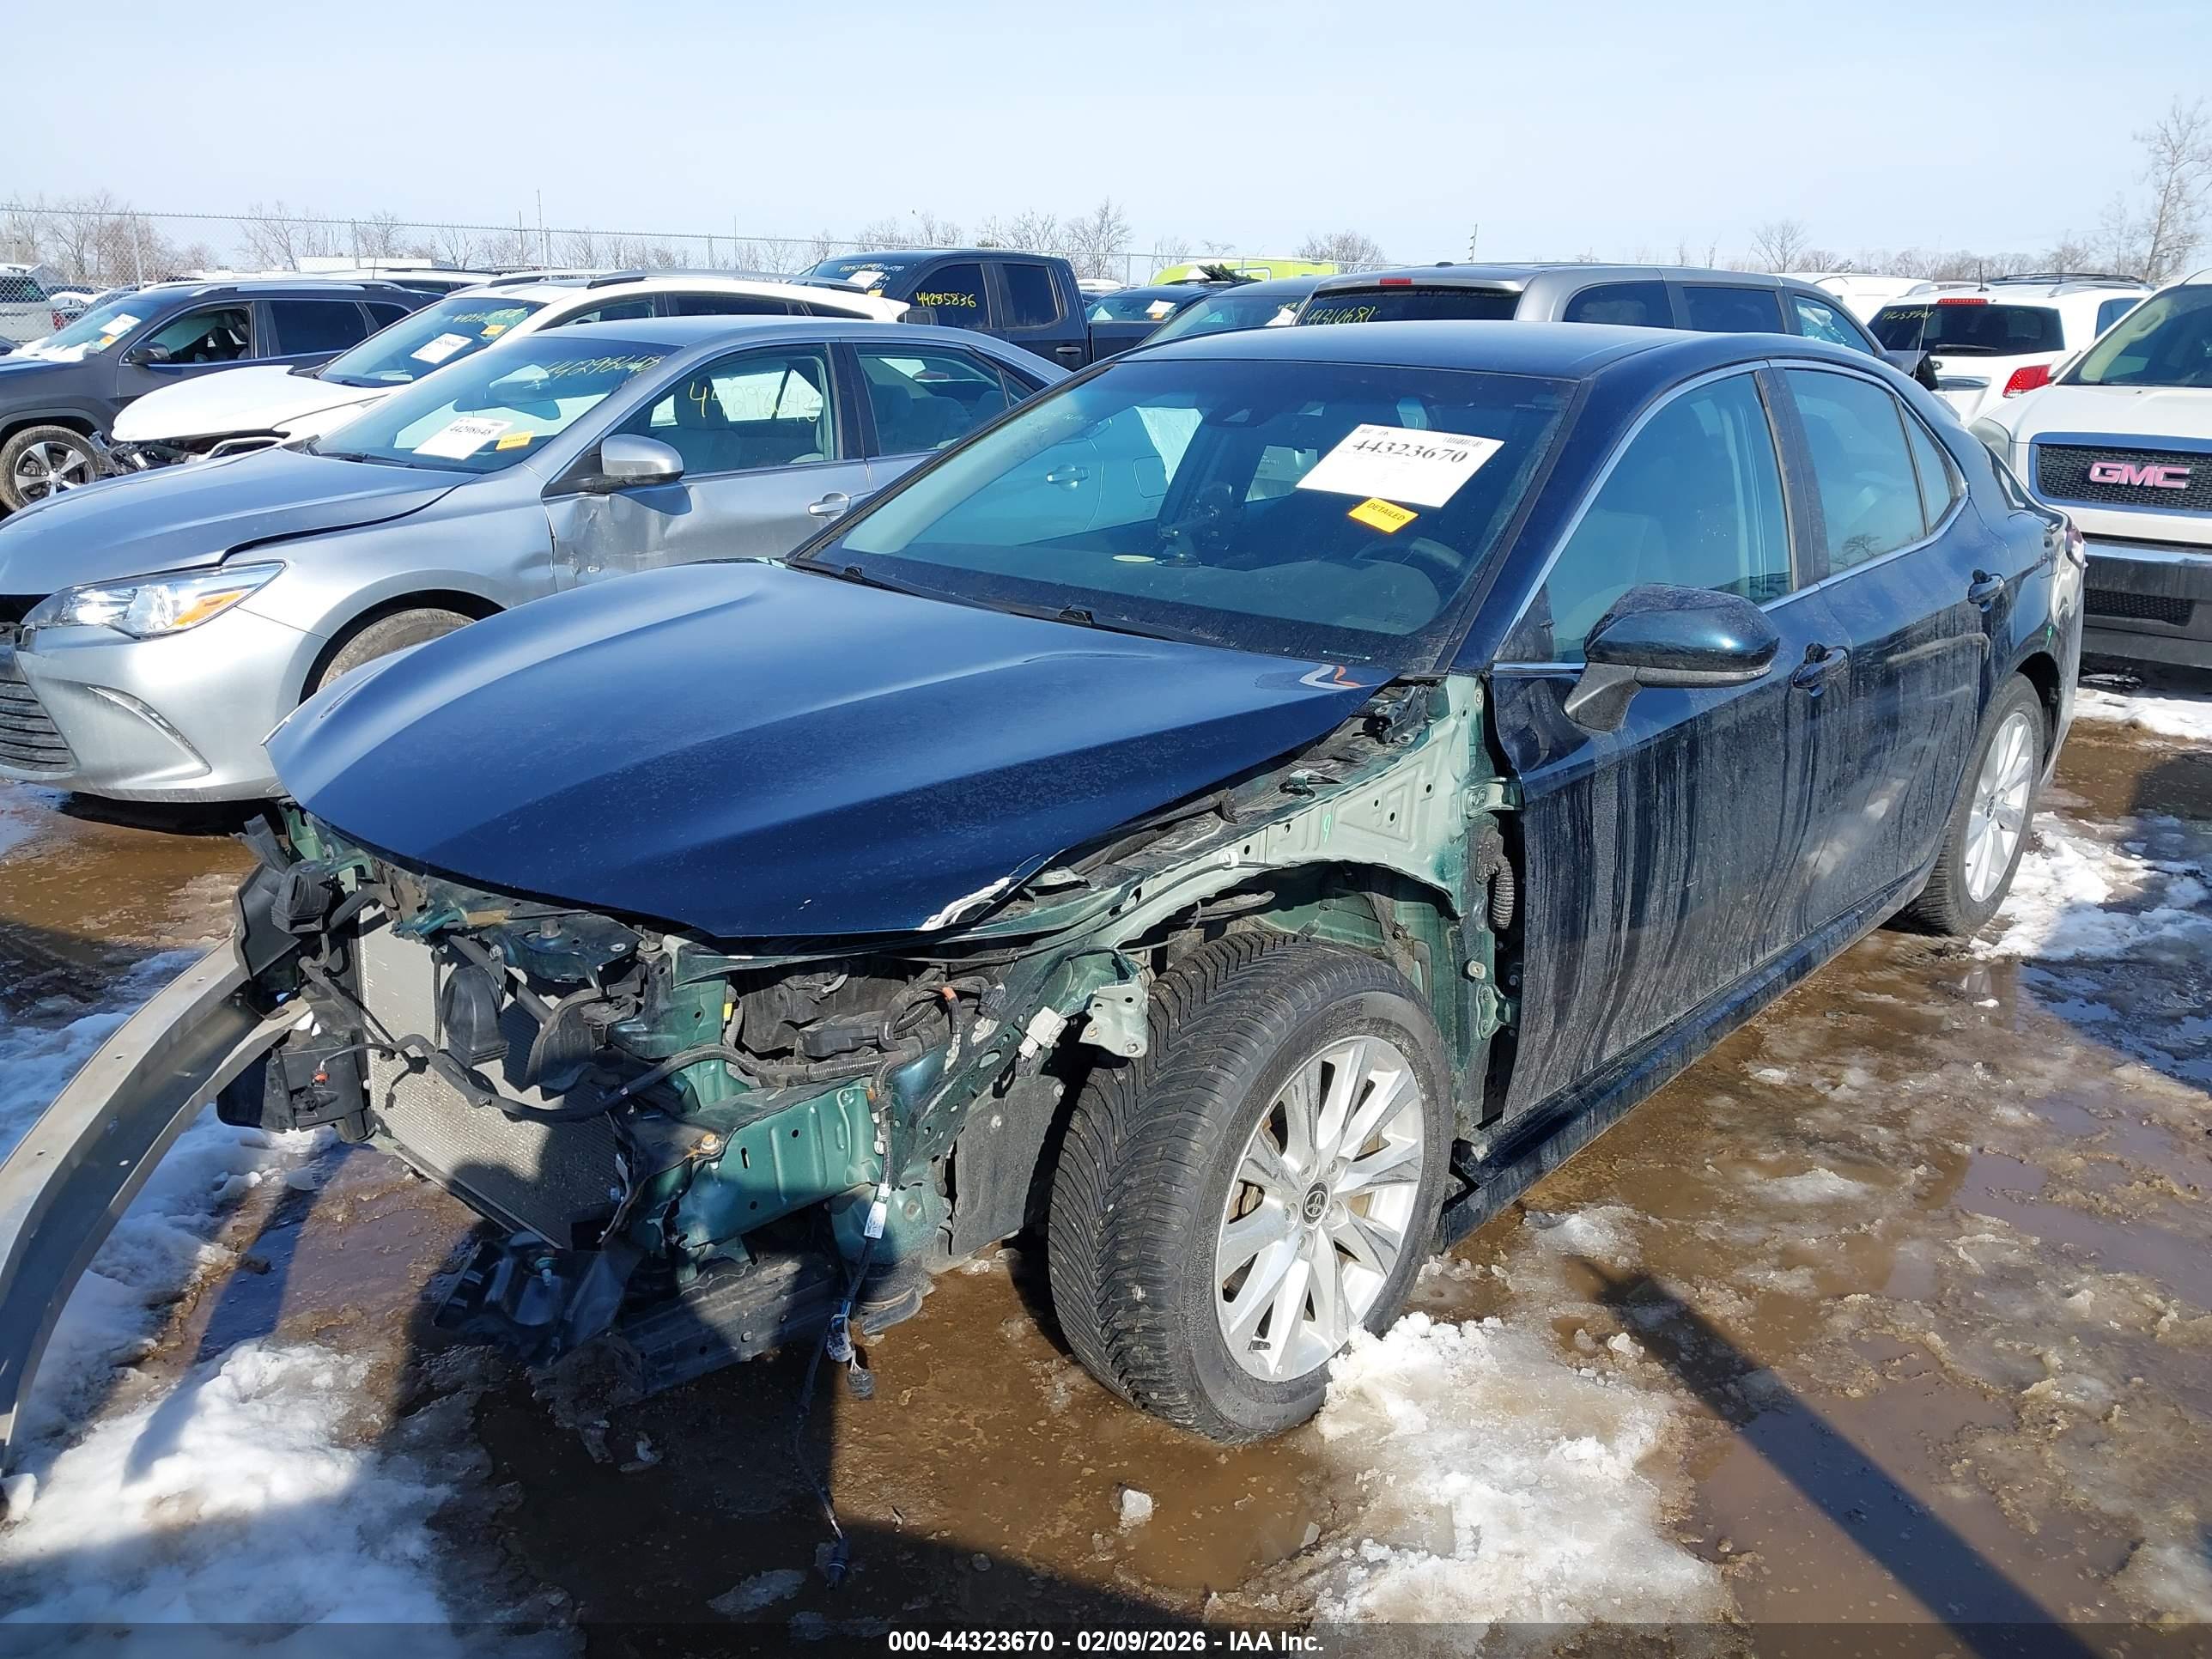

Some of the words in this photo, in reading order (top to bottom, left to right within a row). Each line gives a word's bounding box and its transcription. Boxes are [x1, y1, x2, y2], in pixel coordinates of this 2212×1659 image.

[915, 291, 977, 308] 44285836
[1352, 439, 1469, 464] 44323670
[2088, 461, 2191, 489] GMC
[1366, 501, 1407, 522] DETAILED
